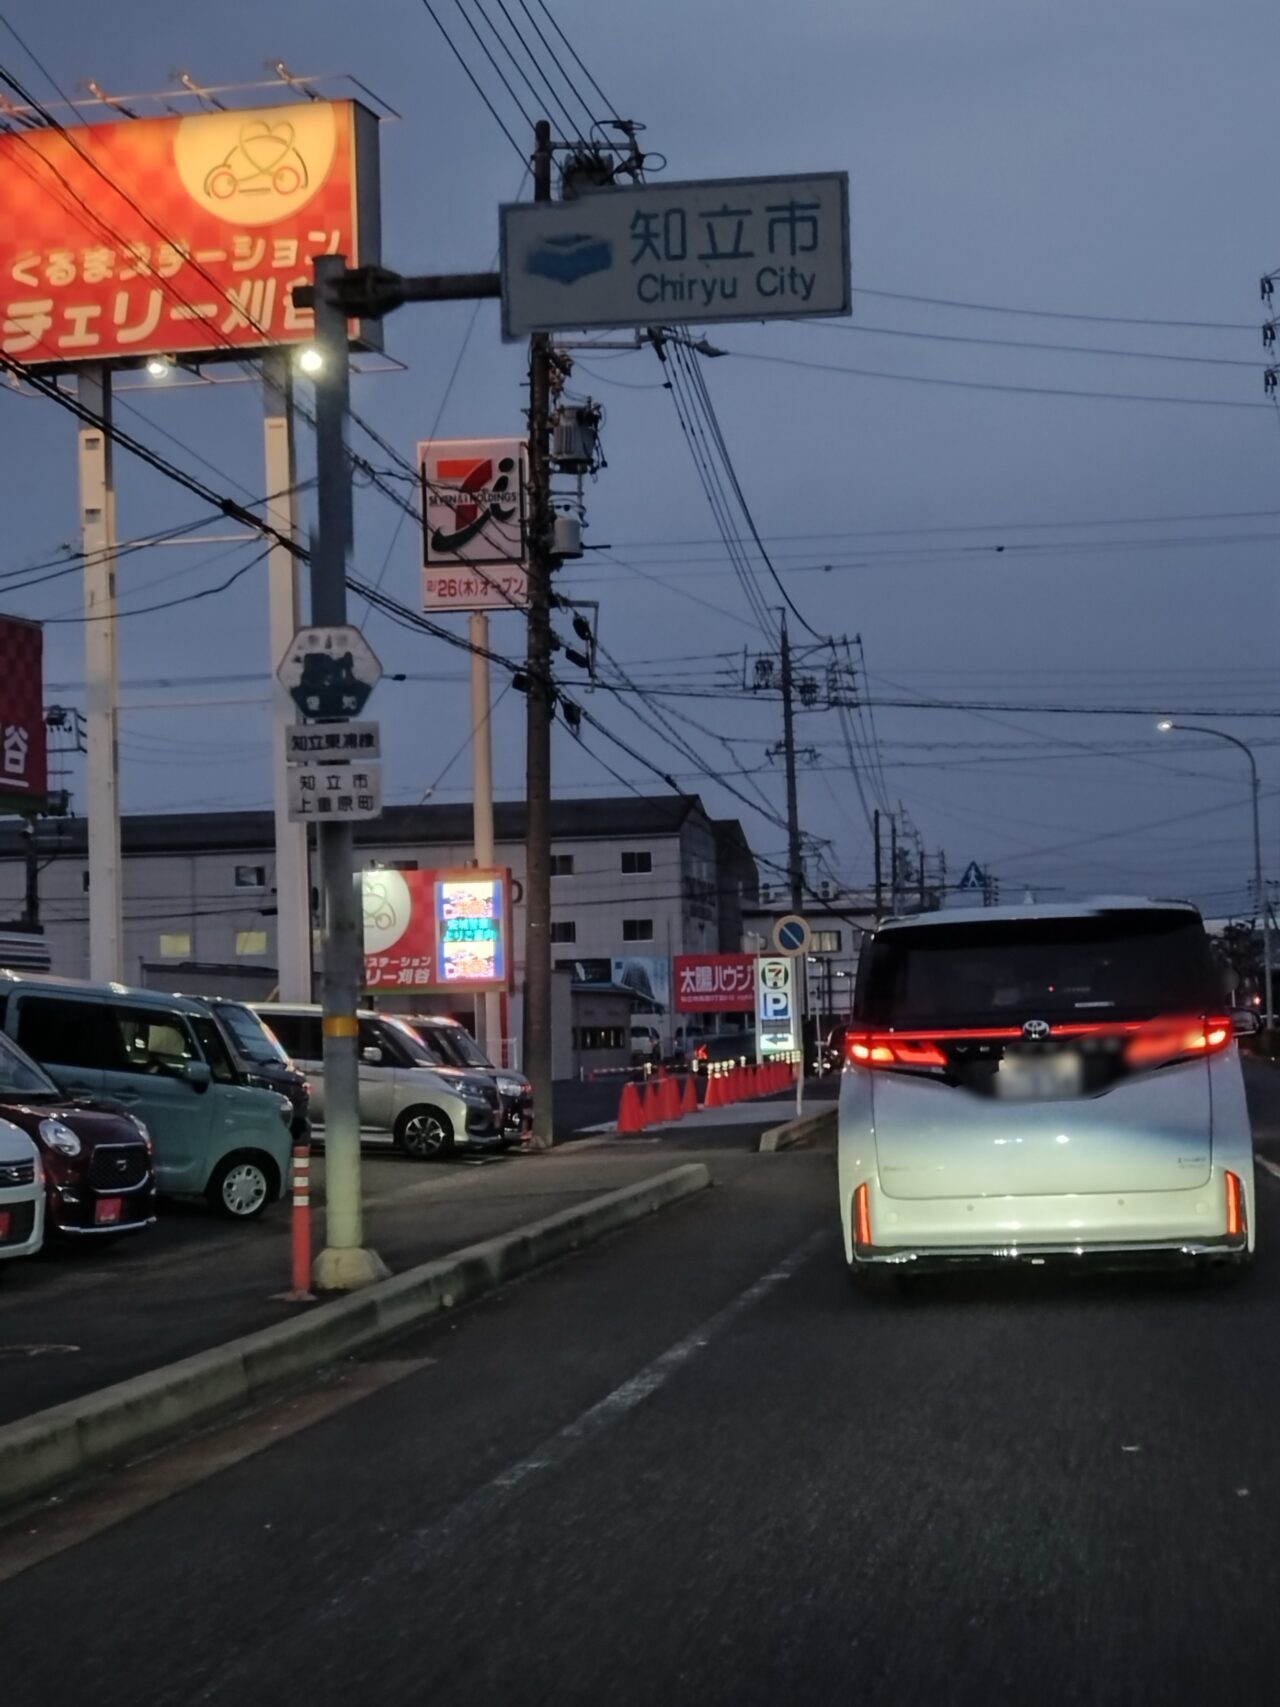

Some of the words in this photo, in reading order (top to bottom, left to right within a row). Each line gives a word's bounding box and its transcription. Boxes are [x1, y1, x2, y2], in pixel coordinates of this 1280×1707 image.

[629, 200, 822, 265] 知立市
[11, 229, 342, 287] くるまステーション
[636, 271, 738, 306] Chiryu
[755, 266, 817, 301] City
[300, 773, 369, 791] 知立市
[679, 964, 755, 993] 太陽ハウジ
